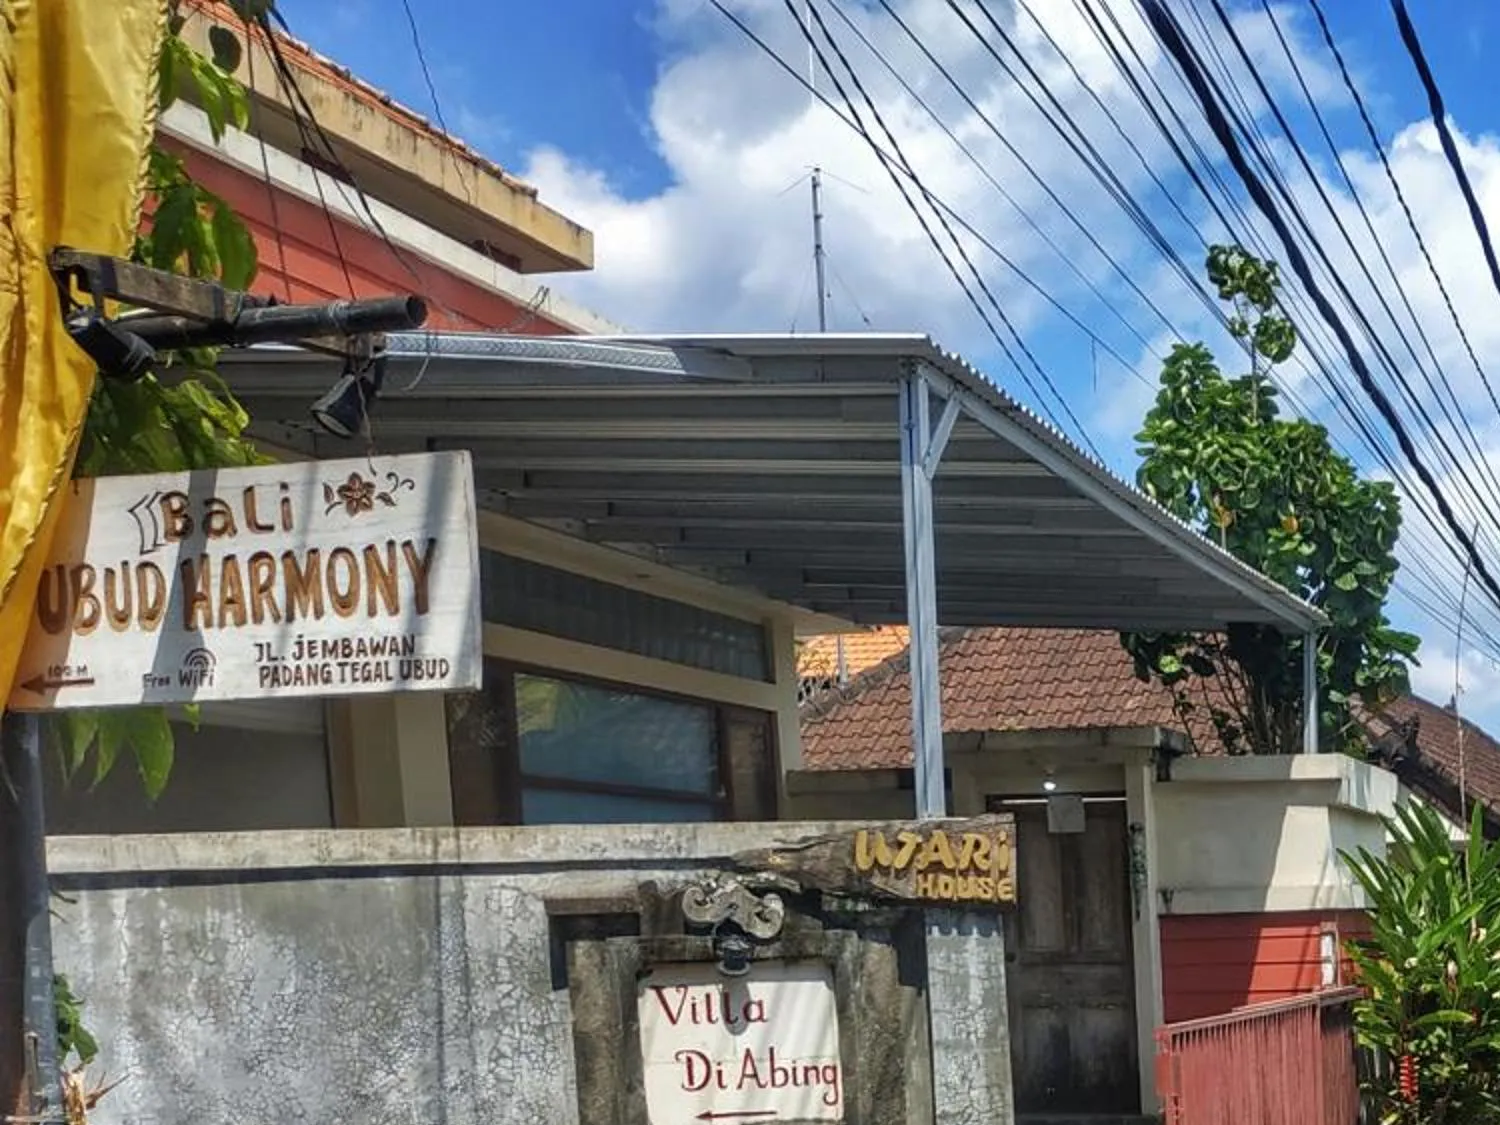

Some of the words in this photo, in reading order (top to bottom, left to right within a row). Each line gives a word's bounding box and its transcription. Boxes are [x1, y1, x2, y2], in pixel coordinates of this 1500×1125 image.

[36, 561, 166, 636] UBUD
[180, 537, 437, 631] HARMONY
[259, 662, 333, 689] PADANG
[336, 659, 393, 684] TEGAL
[398, 657, 450, 681] UBUD
[917, 873, 1014, 901] HOUSE
[652, 984, 768, 1026] Villa
[674, 1048, 726, 1093] Di
[737, 1047, 839, 1106] Abing
